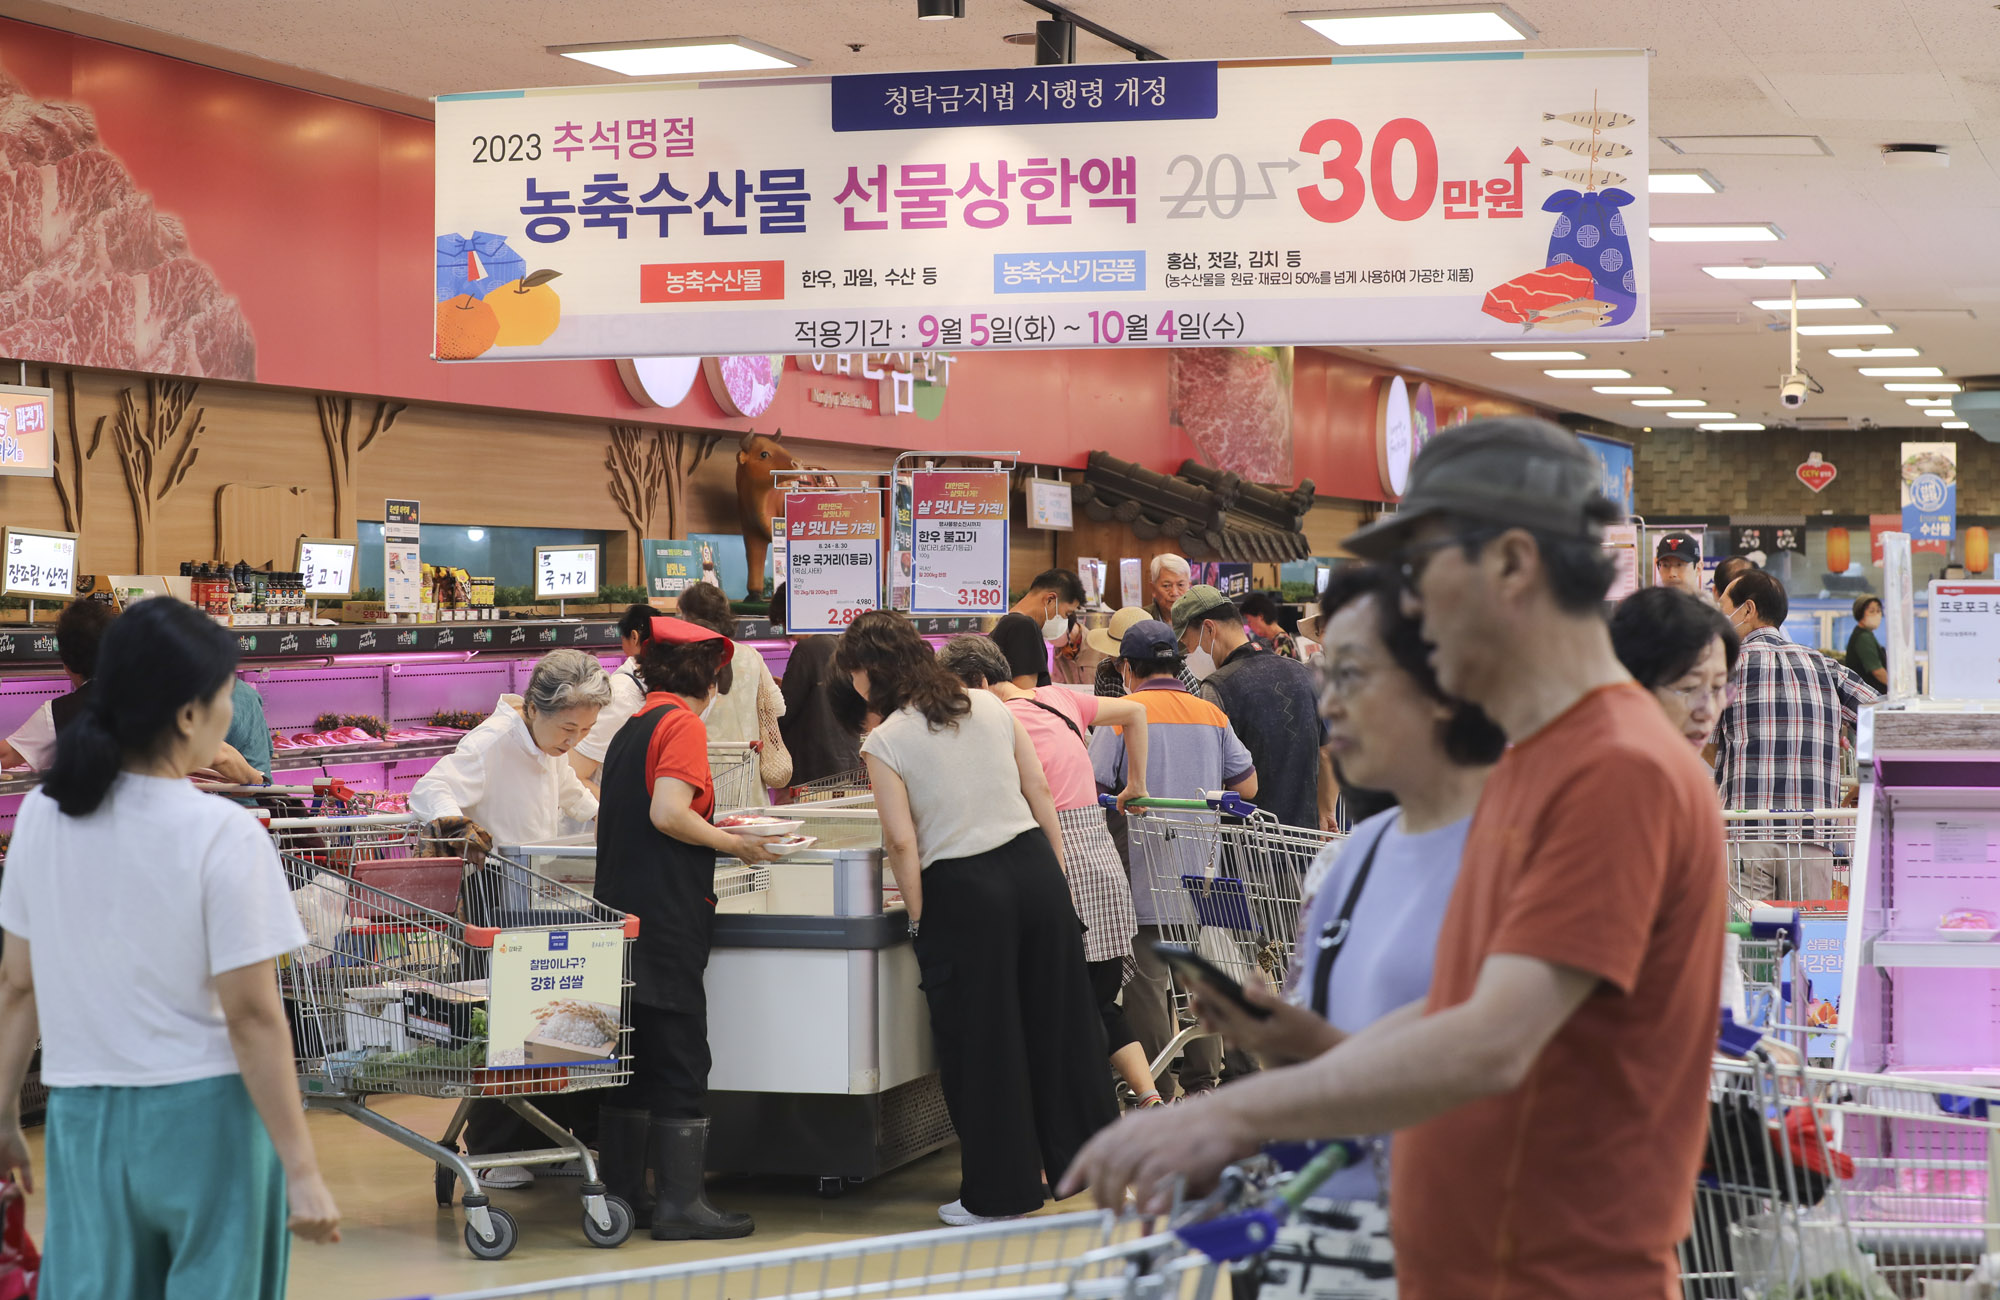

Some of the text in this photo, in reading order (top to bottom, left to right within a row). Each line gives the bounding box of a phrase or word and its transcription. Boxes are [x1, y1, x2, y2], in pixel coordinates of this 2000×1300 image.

[884, 76, 1166, 116] 청탁금지법 시행령 개정
[472, 117, 694, 163] 2023 추석명절
[519, 167, 811, 243] 농축수산물
[833, 156, 1136, 231] 선물상한액
[1166, 153, 1246, 219] 20
[1167, 251, 1302, 270] 홍삼, 젓갈, 김치 등
[1003, 258, 1136, 285] 농축수산가공품
[1165, 272, 1225, 289] (농수산물을
[1295, 271, 1332, 285] 50%를
[1334, 270, 1357, 284] 넘게
[1359, 269, 1406, 284] 사용하여
[1409, 269, 1444, 283] 가공한
[1447, 268, 1474, 283] 제품)
[666, 267, 938, 294] 농축수산물 한우, 과일, 수산 등
[794, 319, 892, 348] 적용기간
[918, 314, 962, 347] 9월
[970, 311, 1055, 346] 5일(화)
[1088, 310, 1148, 343] 10월
[1156, 309, 1244, 342] 4일(수)
[1801, 470, 1819, 478] CCTV
[817, 503, 842, 511] 대한민국
[917, 500, 932, 515] 살
[935, 500, 976, 515] 맛나는
[978, 501, 1004, 515] 가격!
[791, 521, 876, 536] 살 맛나는 가격!
[919, 530, 941, 543] 한우
[944, 530, 977, 543] 불고기
[1920, 522, 1951, 536] 수산물
[792, 553, 873, 567] 한우 국거리(1등급)
[957, 588, 1000, 606] 3,180
[1939, 602, 1989, 613] 프로포크
[828, 608, 873, 625] 2,88
[529, 957, 586, 971] 찰밥이냐구?
[530, 975, 585, 991] 강화 섬쌀
